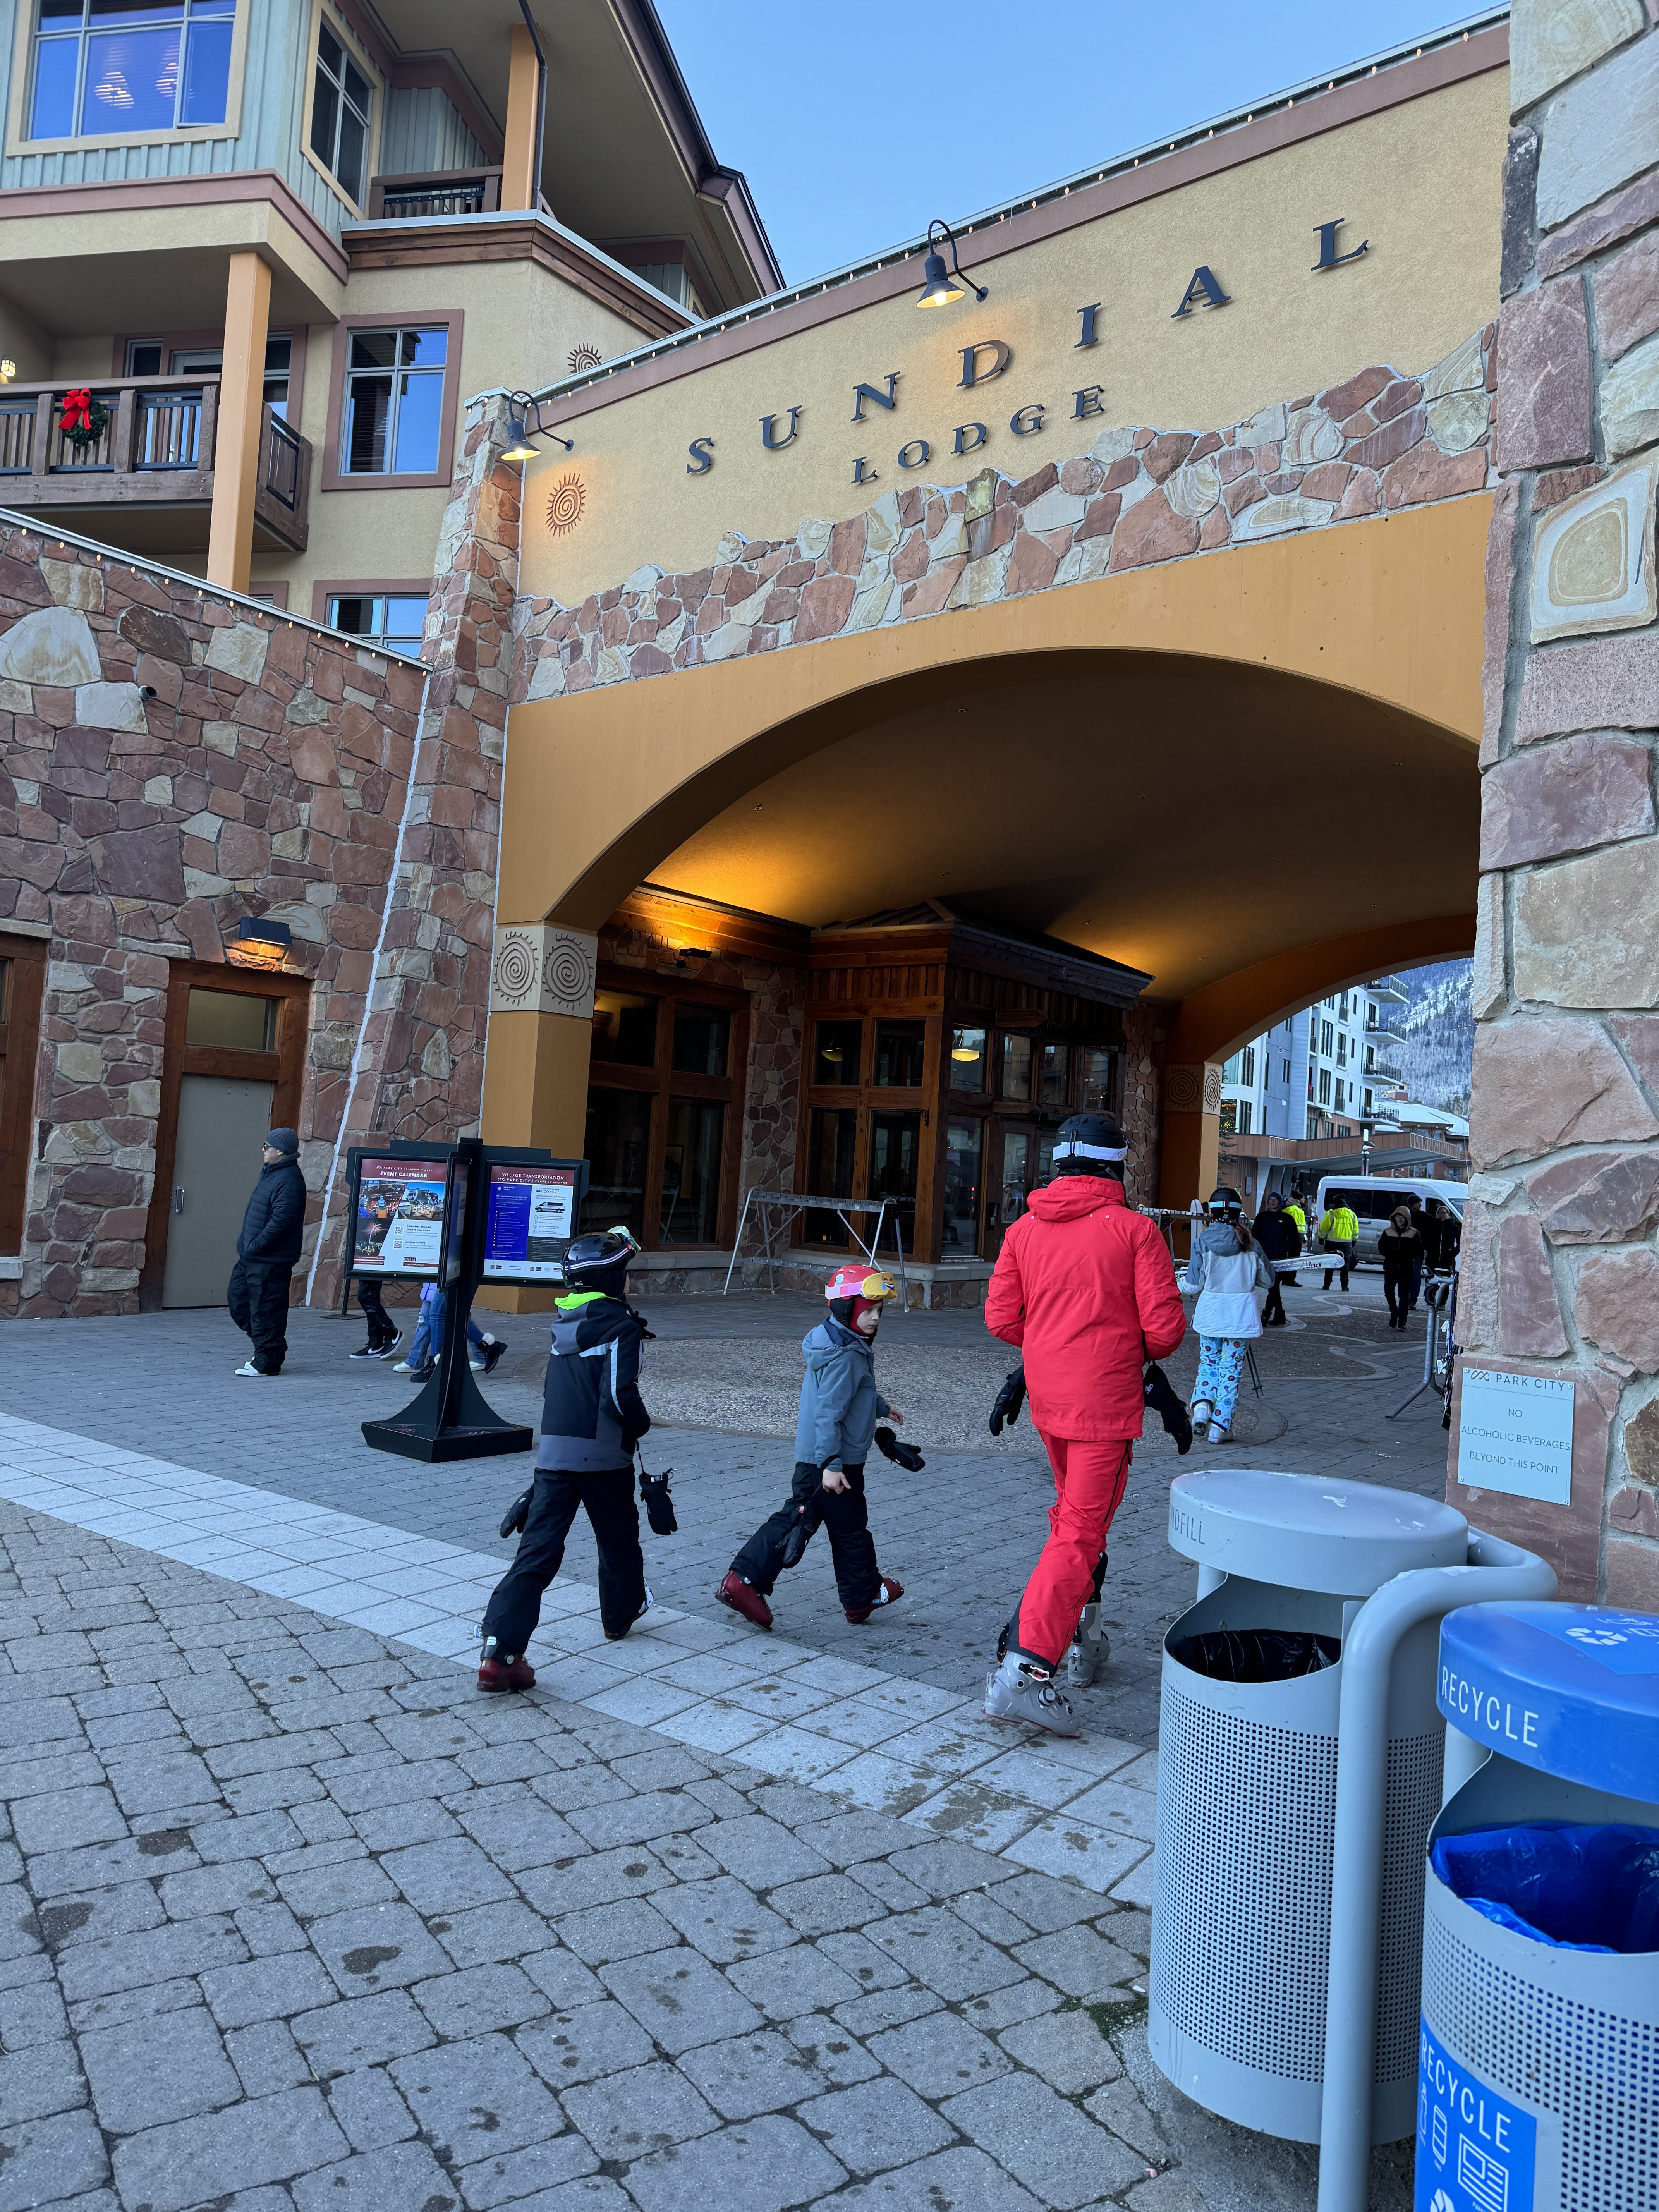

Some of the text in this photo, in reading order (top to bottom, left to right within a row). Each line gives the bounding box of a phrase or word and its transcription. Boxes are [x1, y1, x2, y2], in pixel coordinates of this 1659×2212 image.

[686, 217, 1369, 474] SUNDIAL
[850, 384, 1104, 484] LODGE
[1496, 1374, 1565, 1391] PARK CITY
[1508, 1408, 1522, 1418] NO
[1462, 1426, 1570, 1451] ALCOHOLIC BEVERAGES
[1470, 1451, 1559, 1474] BEYOND THIS POINT
[1170, 1505, 1206, 1546] NDFILL
[1442, 1665, 1539, 1748] RECYCLE
[1422, 2031, 1511, 2154] RECYCLE
